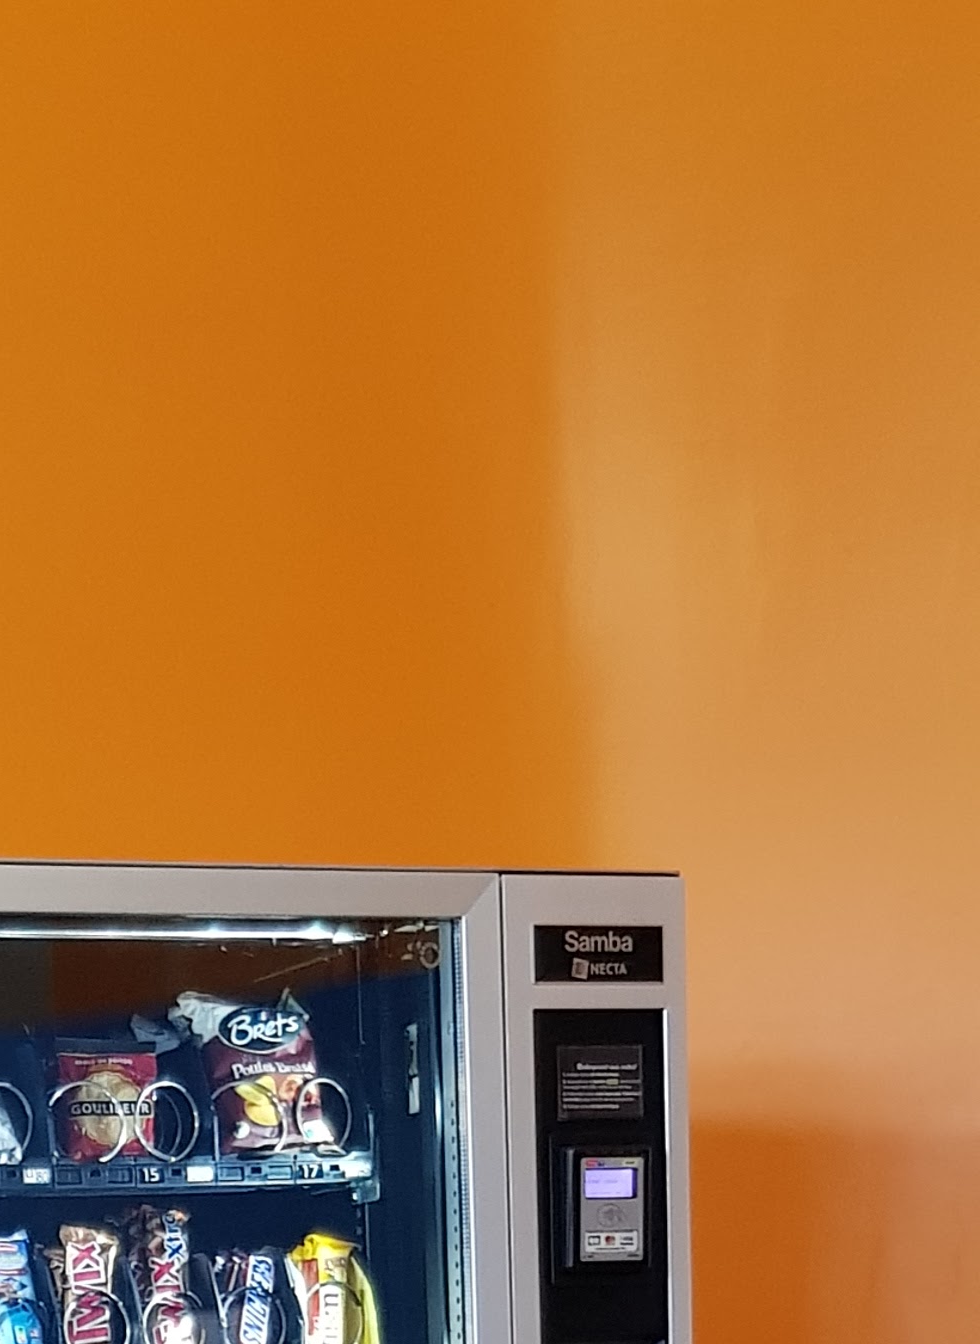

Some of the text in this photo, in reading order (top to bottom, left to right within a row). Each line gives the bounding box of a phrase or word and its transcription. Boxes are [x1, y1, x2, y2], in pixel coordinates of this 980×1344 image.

[564, 930, 634, 953] Samba
[589, 961, 628, 976] NECTA
[142, 1167, 160, 1183] 15
[301, 1164, 319, 1179] 17
[68, 1242, 110, 1344] TWIX
